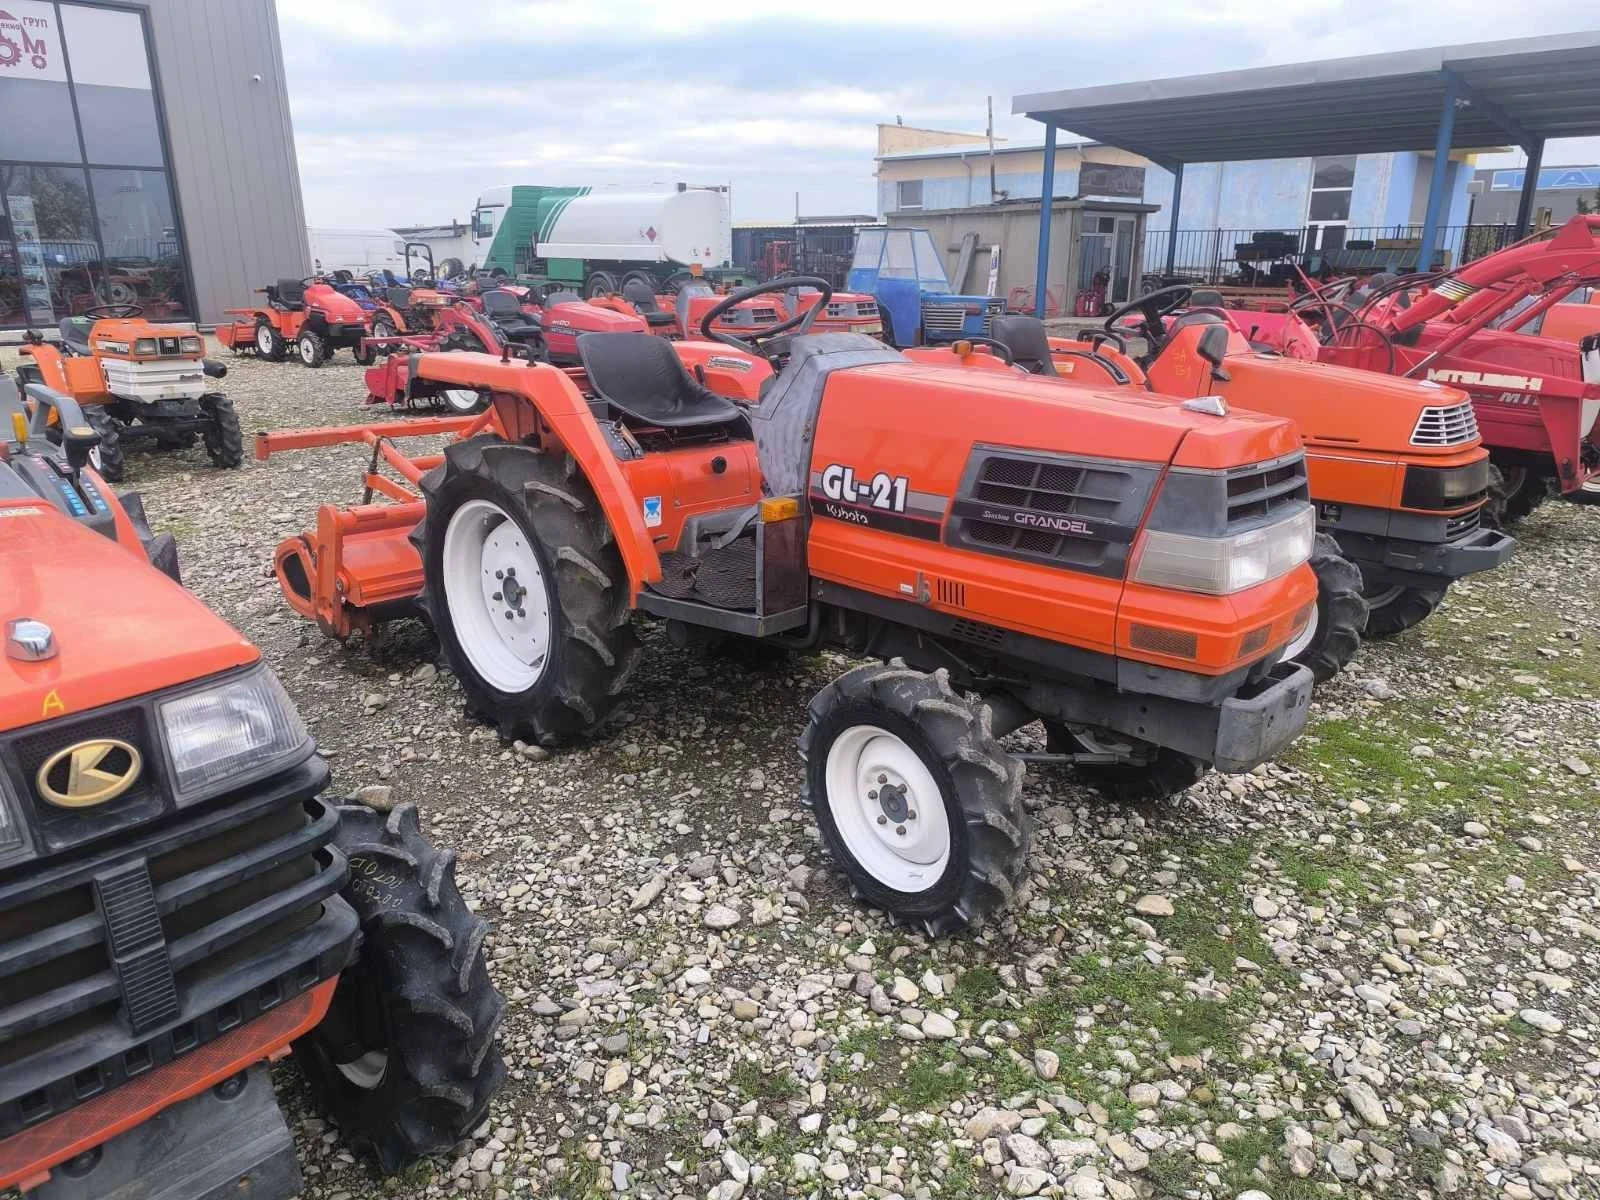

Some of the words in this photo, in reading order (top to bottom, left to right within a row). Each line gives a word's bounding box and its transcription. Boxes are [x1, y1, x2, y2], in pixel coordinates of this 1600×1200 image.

[822, 464, 908, 513] GL-21
[826, 503, 869, 524] Kubota
[1014, 512, 1094, 535] GRANDEL
